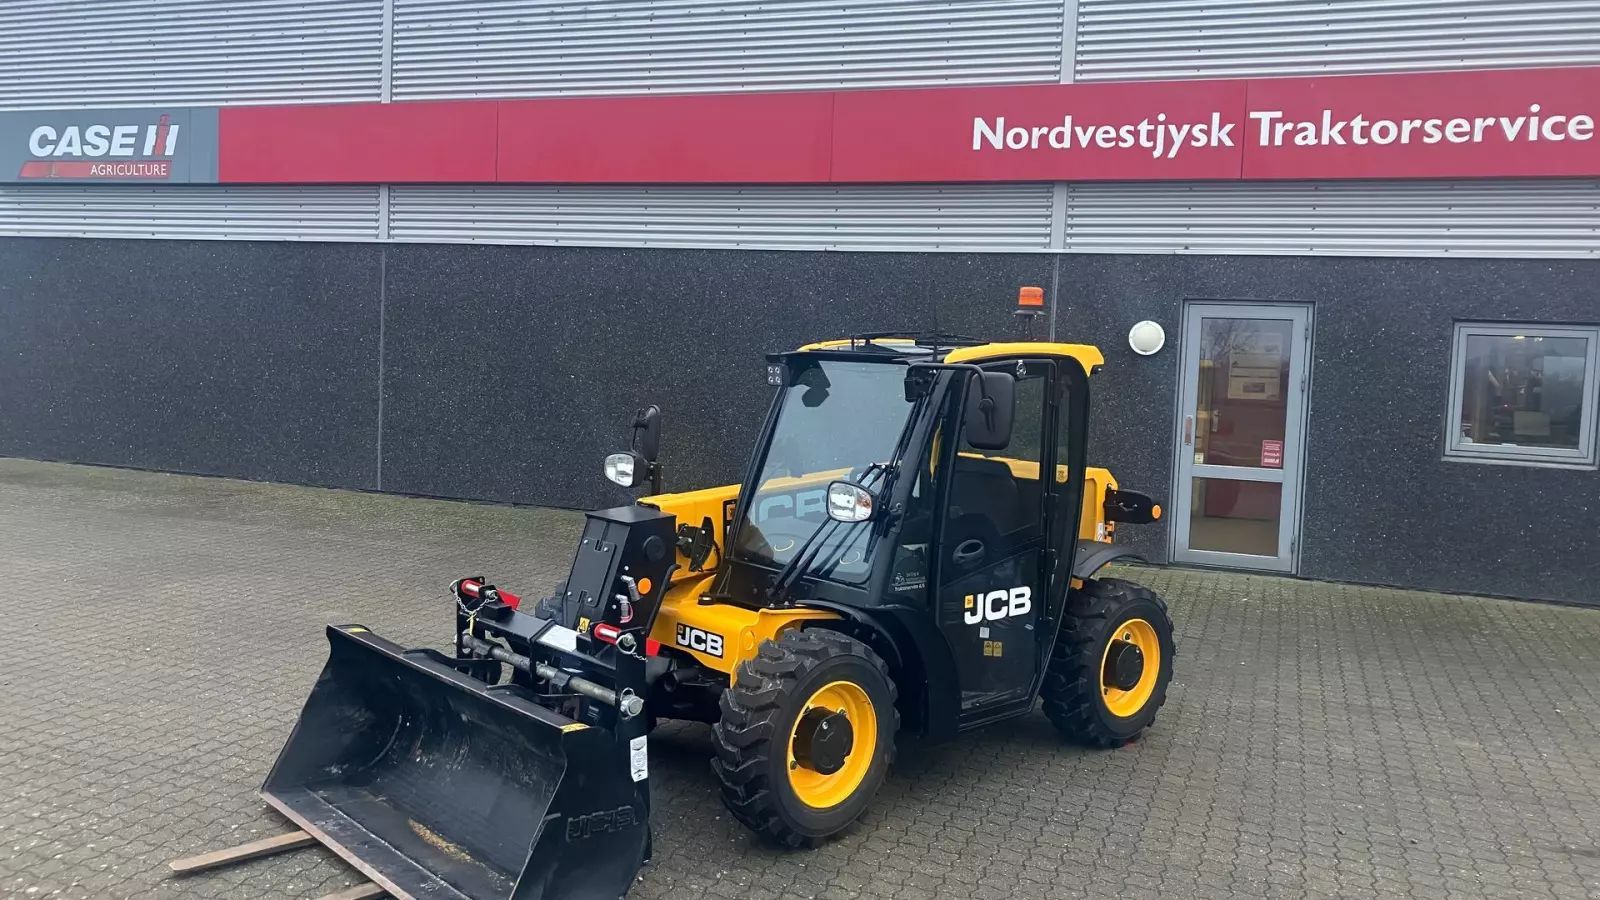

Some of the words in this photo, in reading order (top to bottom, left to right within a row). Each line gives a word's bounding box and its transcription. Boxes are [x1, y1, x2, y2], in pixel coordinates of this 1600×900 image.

[28, 124, 139, 157] CASE
[972, 112, 1236, 159] Nordvestjysk
[1249, 103, 1595, 146] Traktorservice
[90, 164, 168, 176] AGRICULTURE
[964, 586, 1032, 625] JCB
[677, 625, 723, 656] JCB
